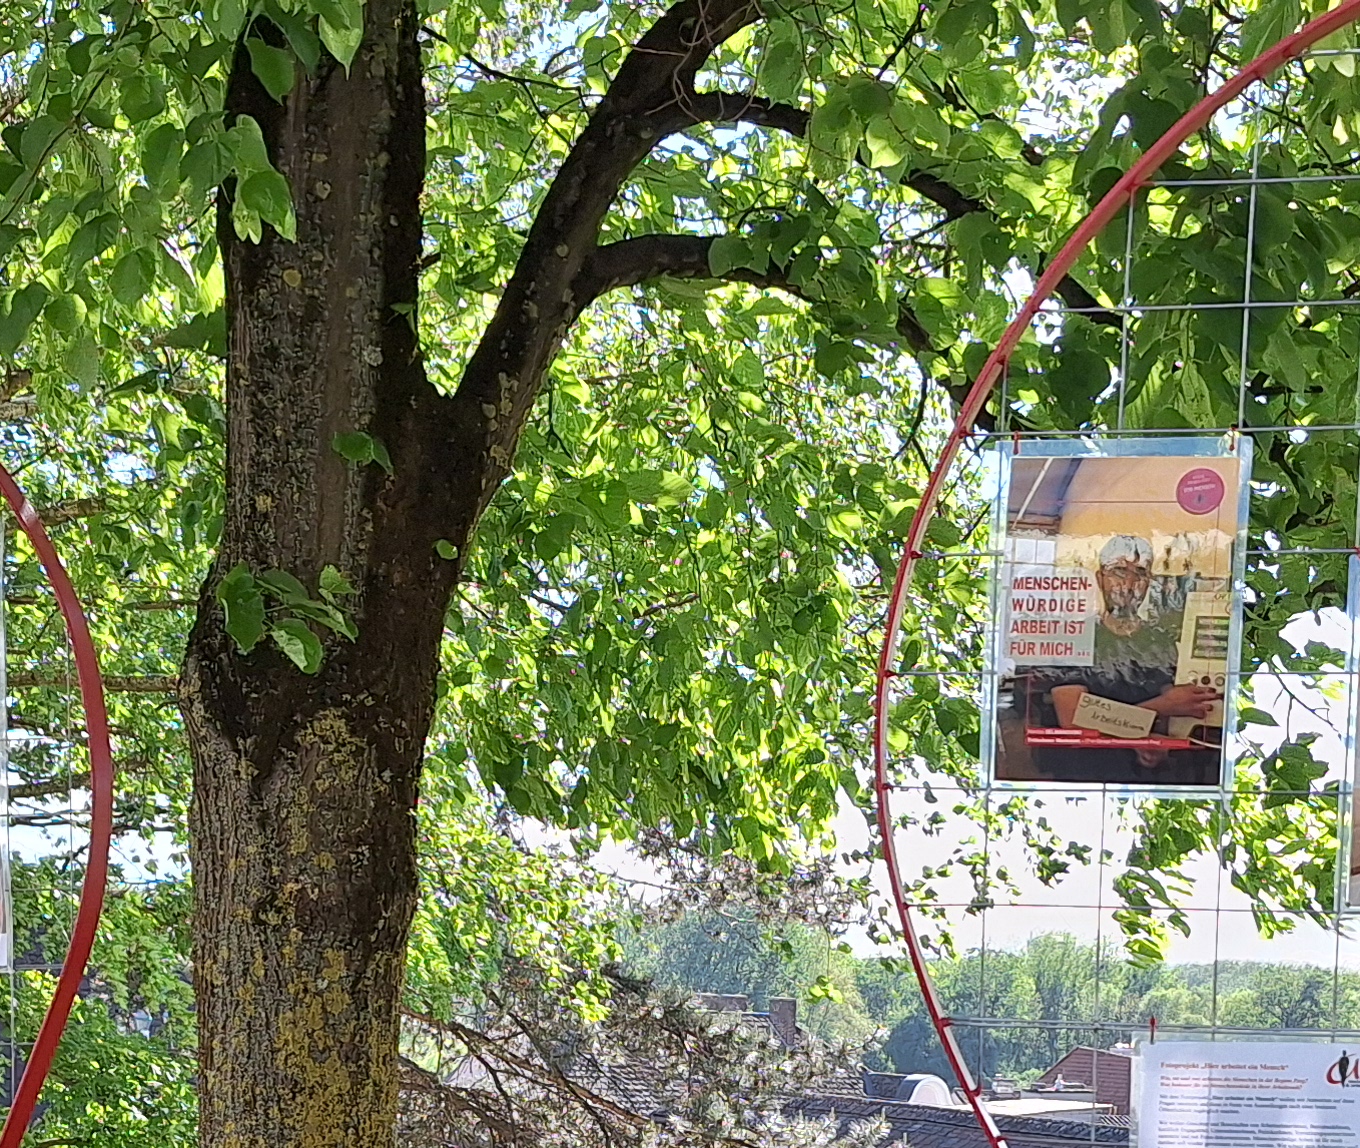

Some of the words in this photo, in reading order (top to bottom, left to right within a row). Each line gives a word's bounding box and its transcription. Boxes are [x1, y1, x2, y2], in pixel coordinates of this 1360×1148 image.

[1013, 577, 1092, 591] MENSCHEN-
[1012, 597, 1086, 612] WÜRDIGE
[1010, 620, 1058, 634] ARBEIT
[1064, 620, 1085, 633] IST
[1010, 640, 1036, 656] FÜR
[1040, 642, 1073, 655] MICH
